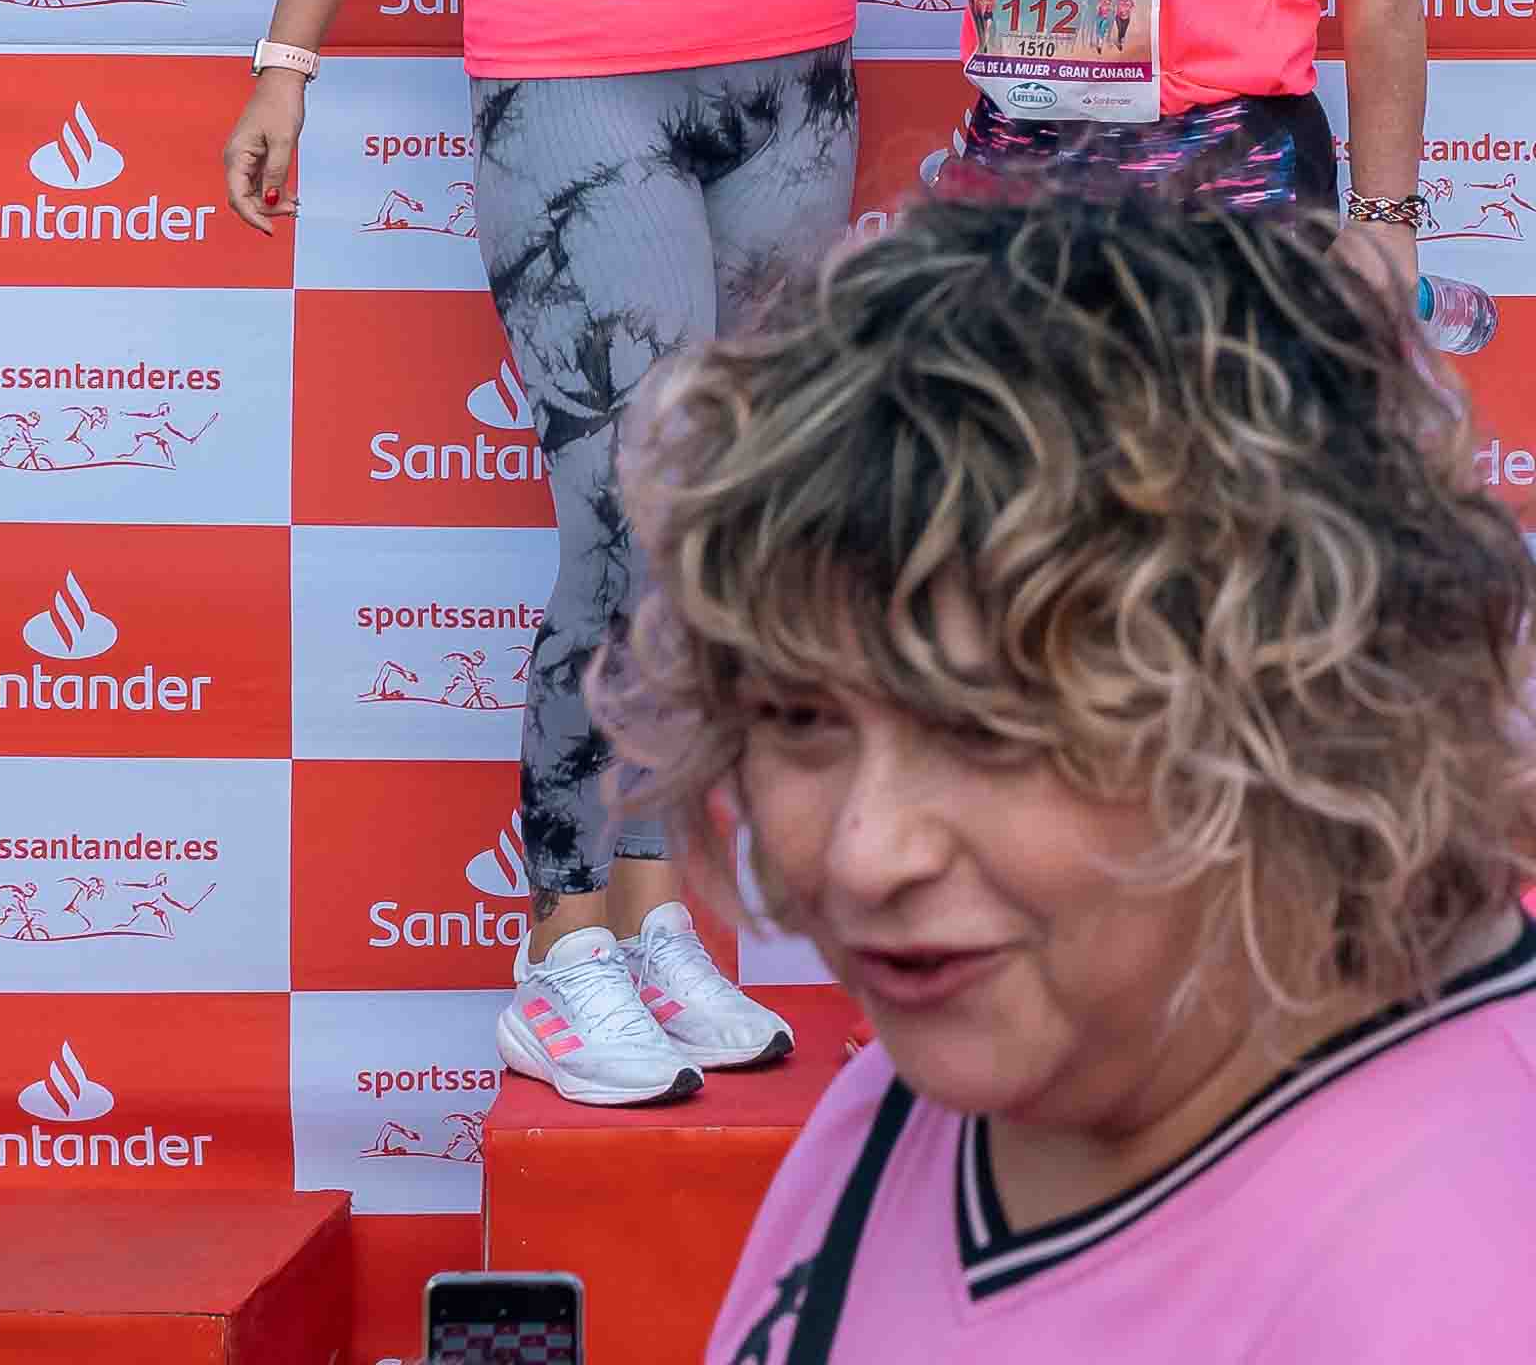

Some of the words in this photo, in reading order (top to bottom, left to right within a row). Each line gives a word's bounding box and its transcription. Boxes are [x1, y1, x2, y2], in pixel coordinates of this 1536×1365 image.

[1017, 40, 1056, 58] 1510
[987, 61, 999, 73] DE
[1000, 62, 1012, 75] LA
[1015, 63, 1050, 76] MUJER
[1058, 66, 1090, 79] GRAN
[1093, 67, 1144, 79] CANARIA
[370, 432, 543, 481] Santa
[357, 602, 544, 638] sportssanta
[368, 901, 528, 947] Santa
